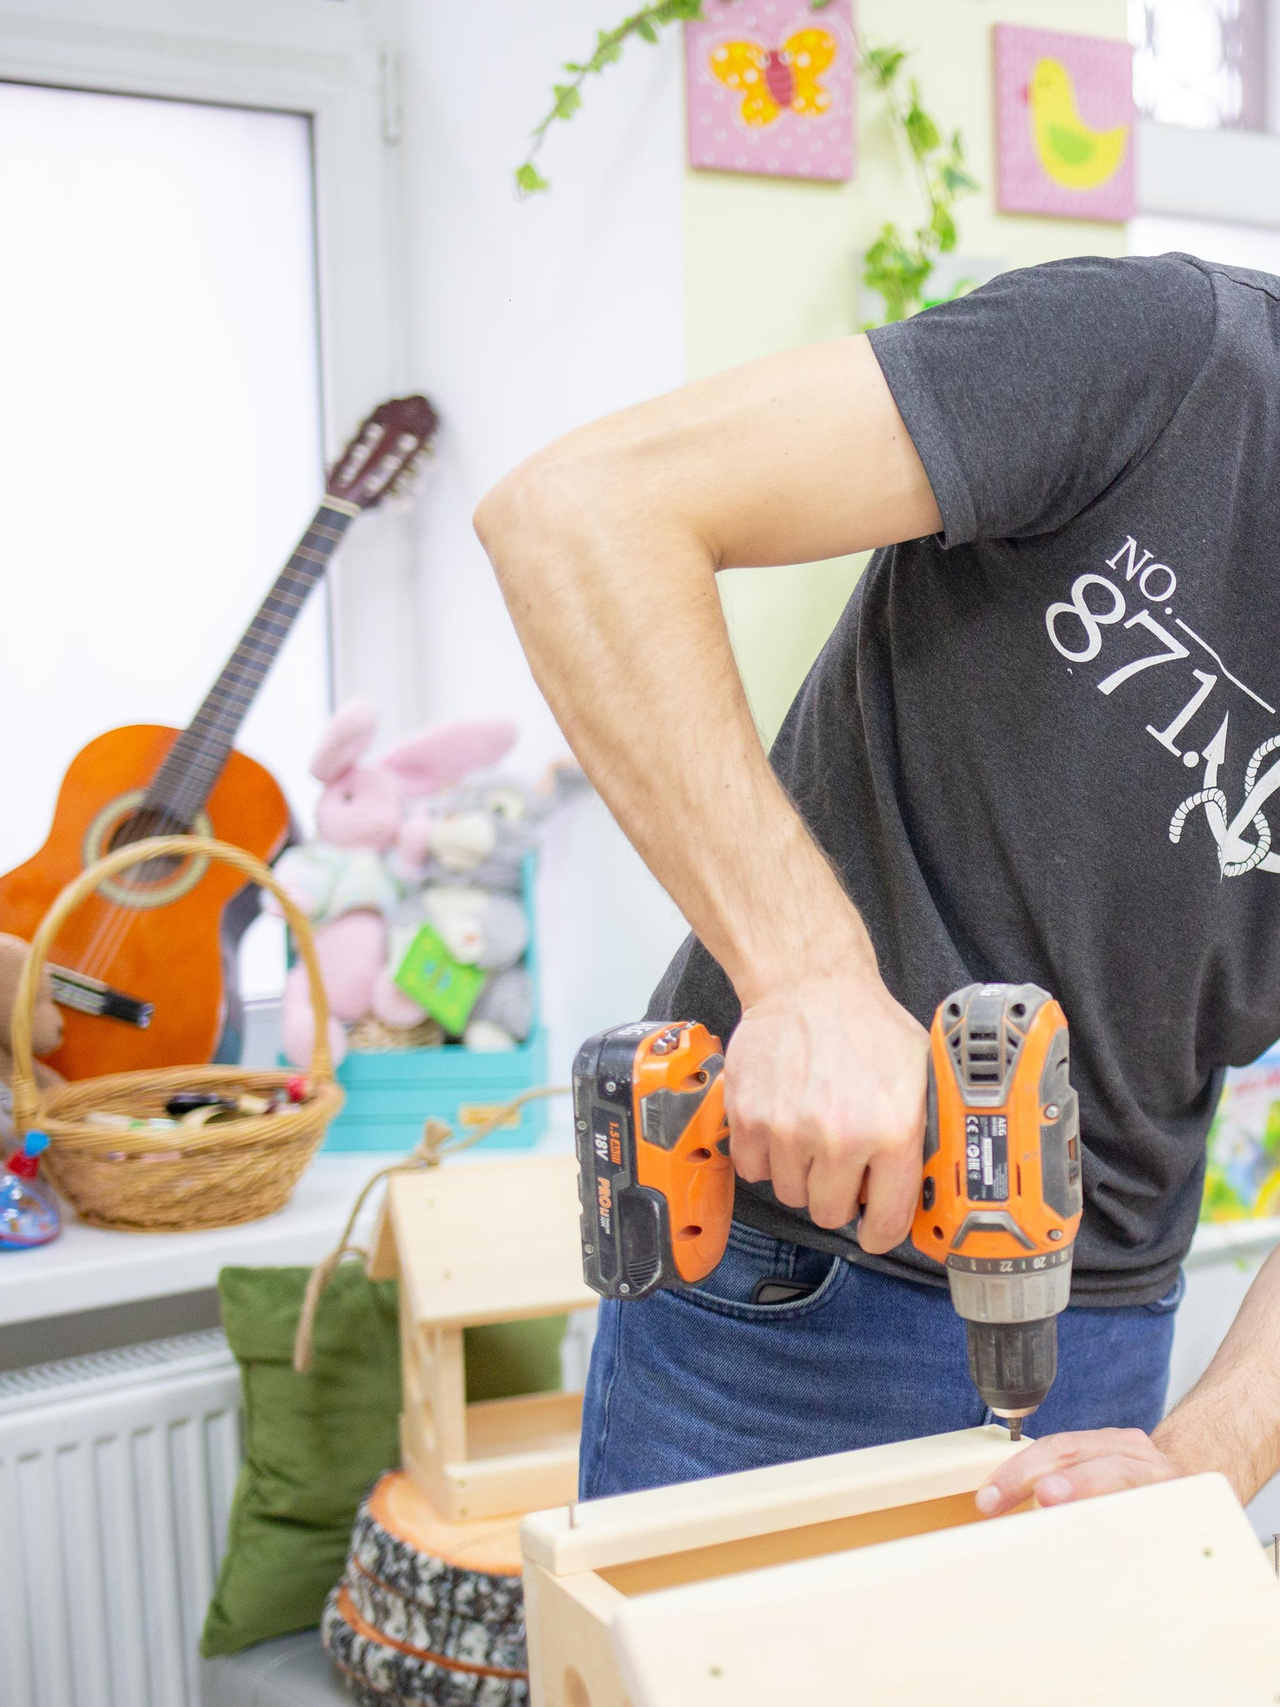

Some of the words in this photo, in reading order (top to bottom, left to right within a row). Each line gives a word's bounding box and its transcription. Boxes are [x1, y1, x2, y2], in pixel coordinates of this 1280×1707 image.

[1105, 535, 1177, 615] NO.
[1045, 573, 1219, 768] 871.
[594, 1133, 609, 1161] 18V
[1000, 1261, 1014, 1272] 22
[1033, 1256, 1046, 1269] 20
